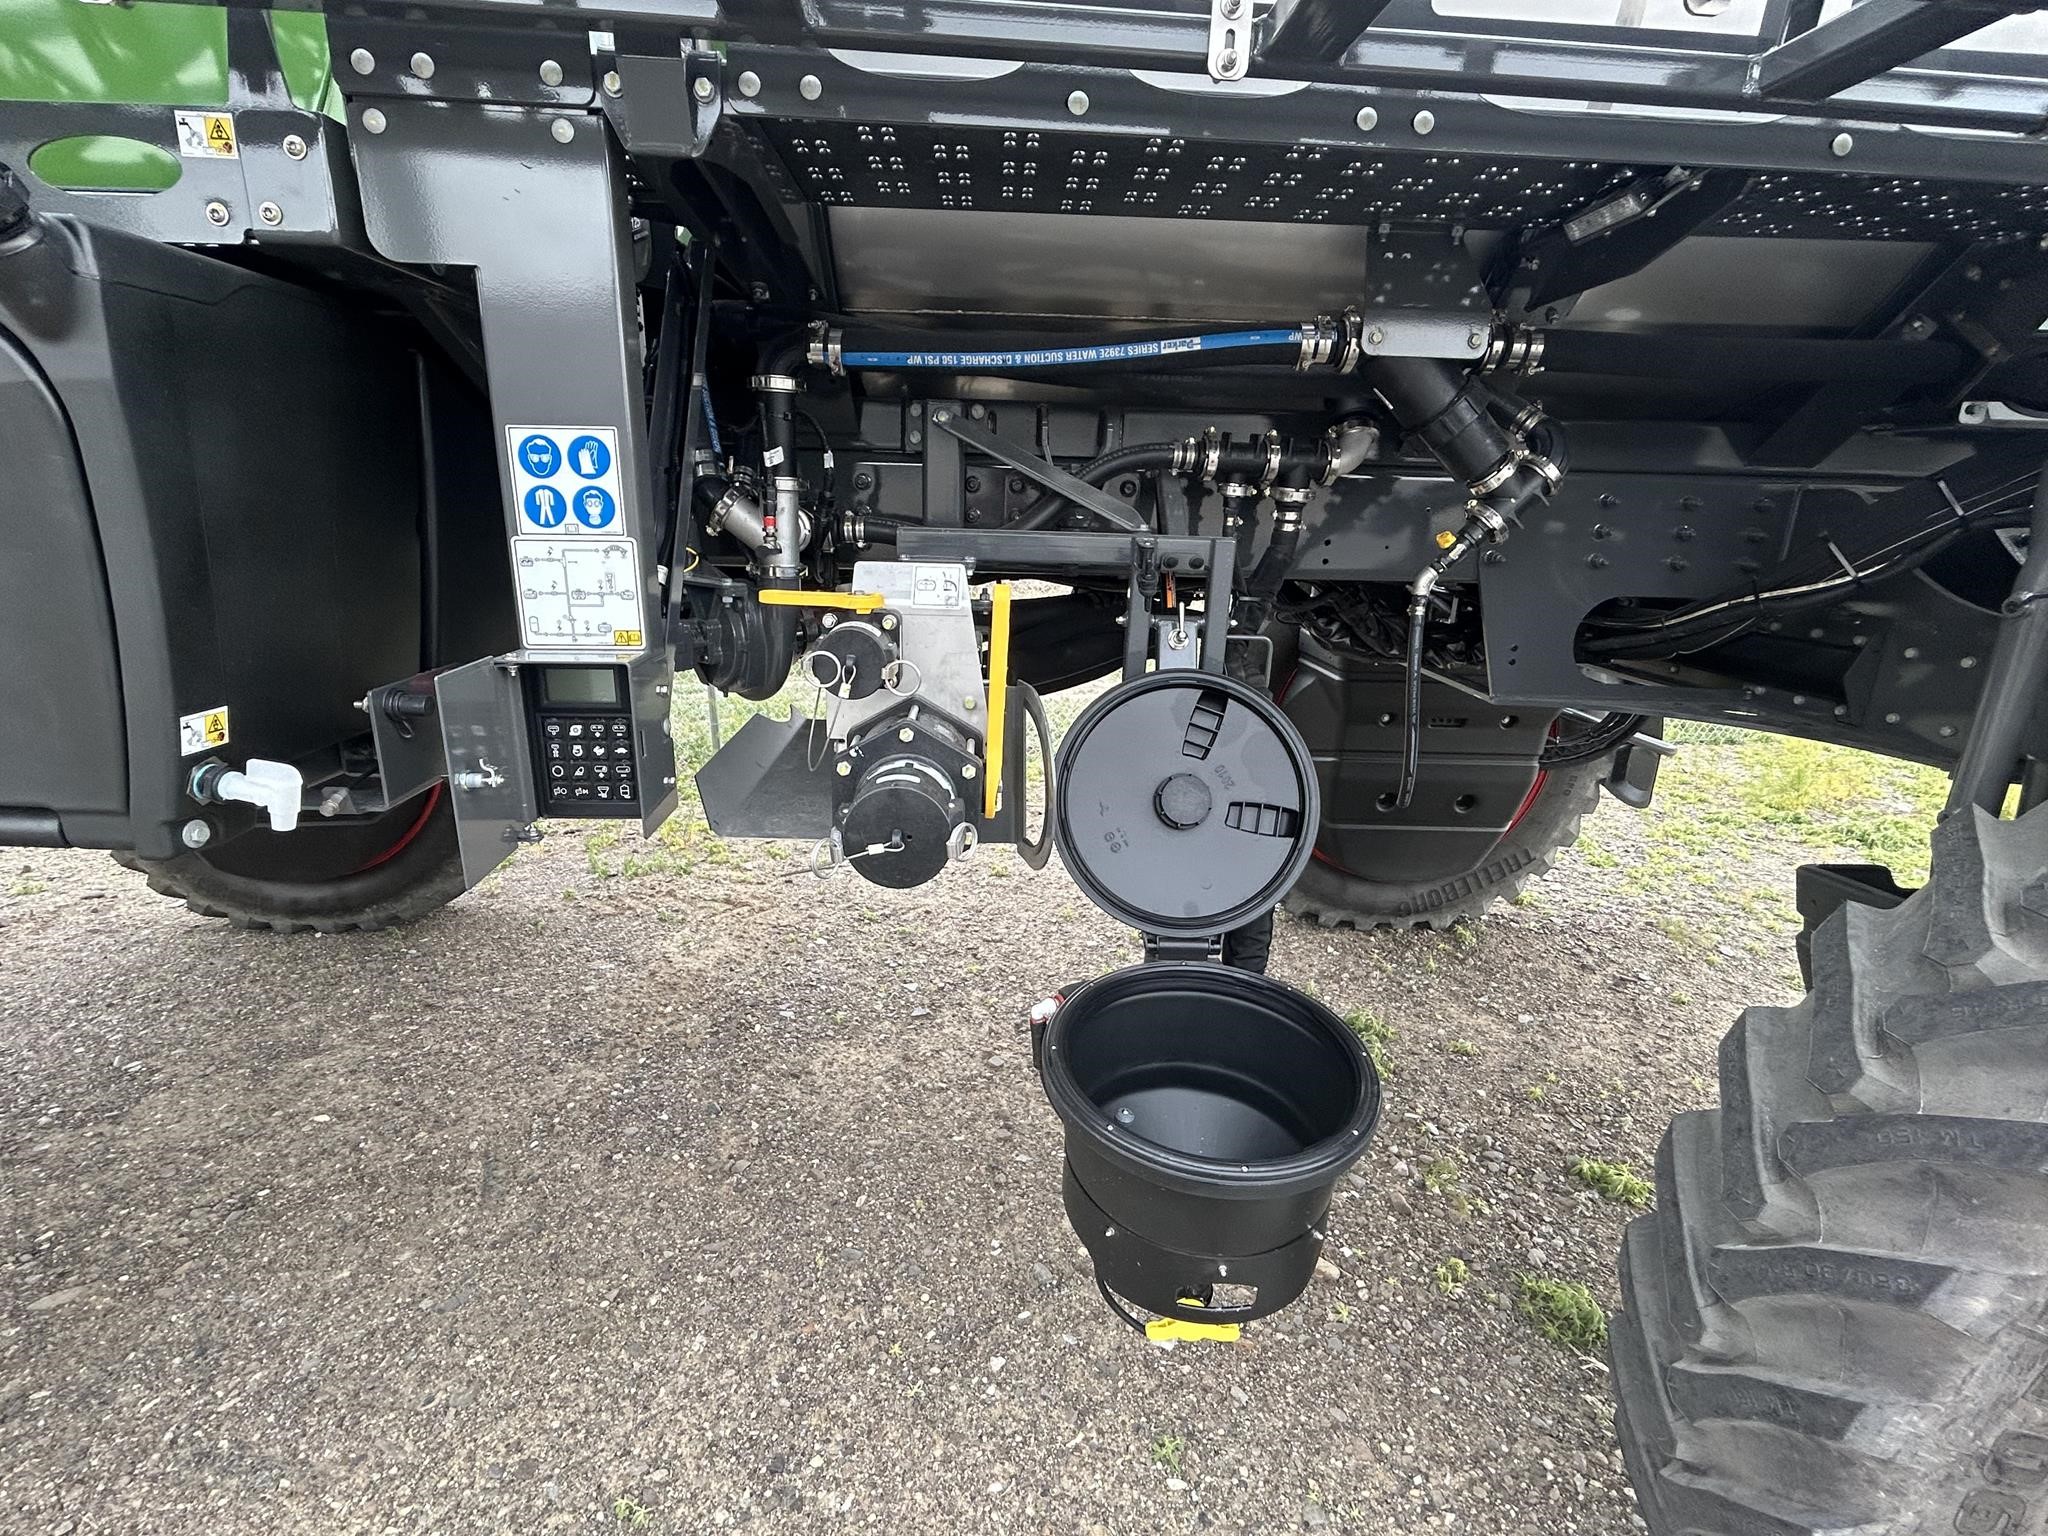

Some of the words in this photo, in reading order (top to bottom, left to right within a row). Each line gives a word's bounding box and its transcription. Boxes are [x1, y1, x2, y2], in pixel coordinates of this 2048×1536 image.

[1128, 342, 1159, 356] SERIES
[1162, 339, 1194, 350] Parker
[1024, 351, 1063, 364] SUCTION
[1066, 349, 1097, 361] WATER
[1099, 346, 1125, 358] 7392E
[906, 355, 923, 364] WP
[925, 355, 940, 364] PSI
[1014, 354, 1022, 364] &
[1398, 847, 1537, 918] TRELLEBORG
